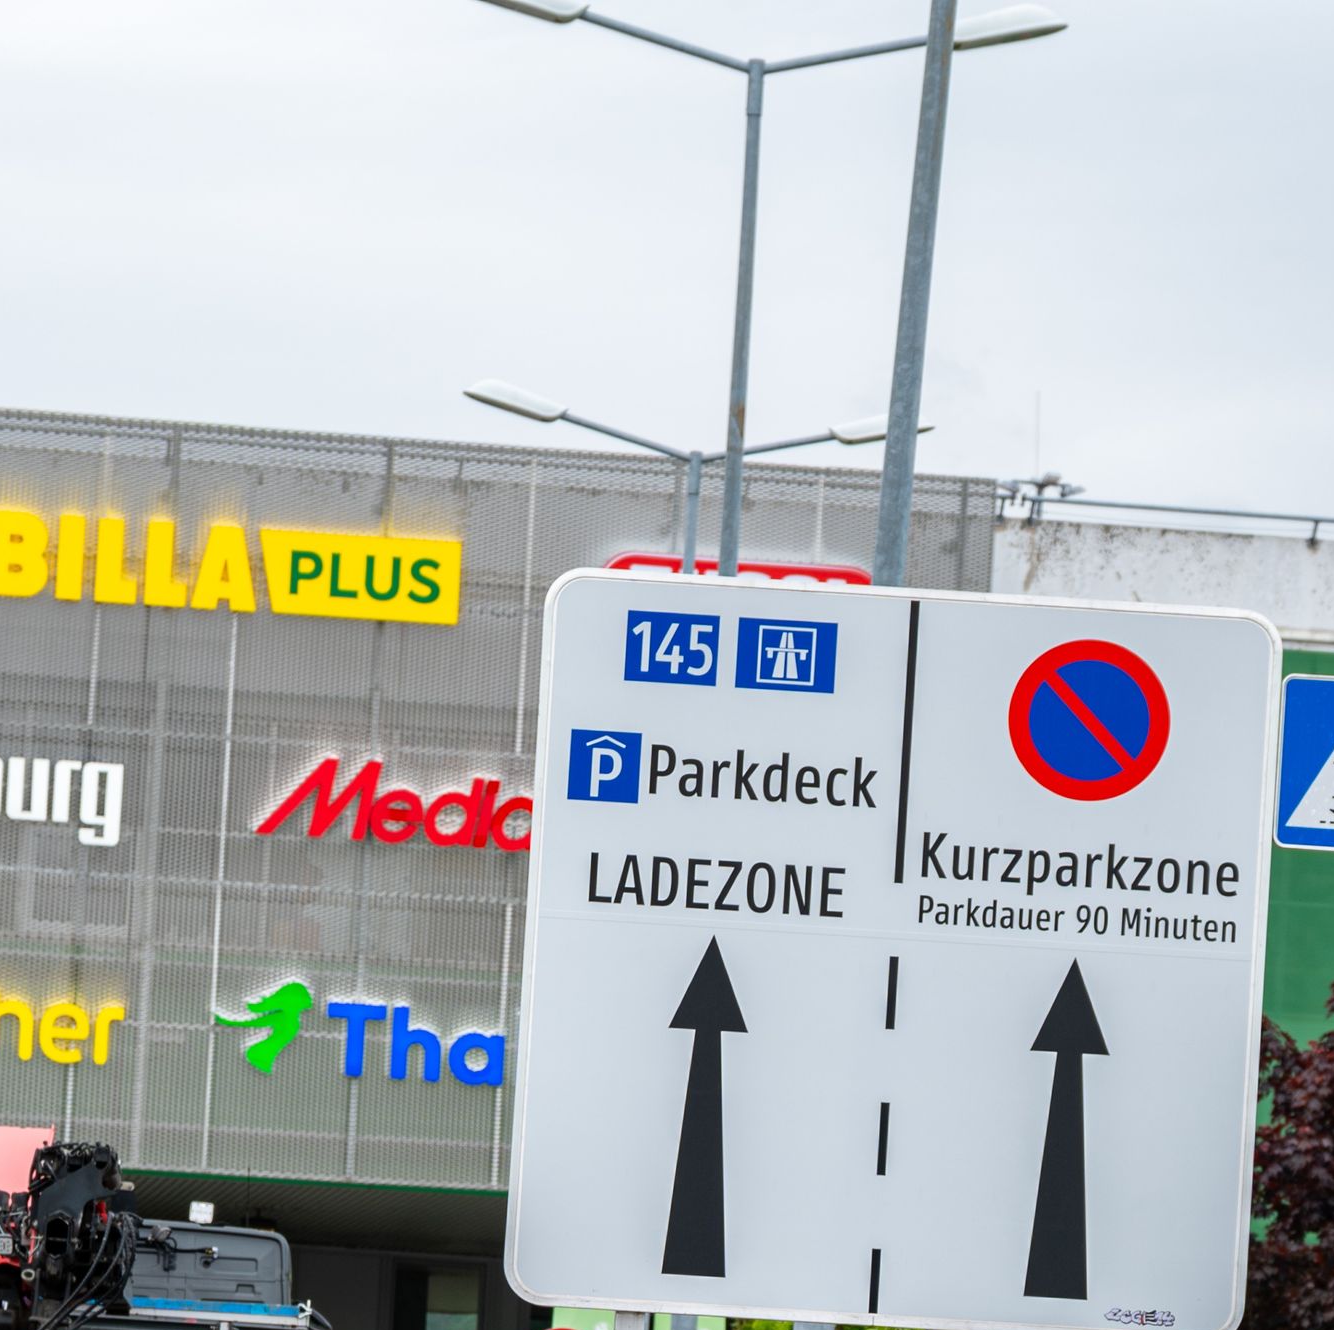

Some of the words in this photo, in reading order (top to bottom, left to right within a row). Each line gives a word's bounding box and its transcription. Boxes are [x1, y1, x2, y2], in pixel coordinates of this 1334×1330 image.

[288, 550, 442, 605] PLUS
[631, 618, 715, 678] 145
[648, 743, 878, 809] Parkdeck
[587, 851, 847, 919] LADEZONE
[920, 831, 1241, 898] Kurzparkzone
[917, 895, 1065, 934] Parkdauer
[1075, 905, 1110, 937] 90
[1119, 907, 1238, 944] Minuten
[327, 1001, 505, 1086] Tha
